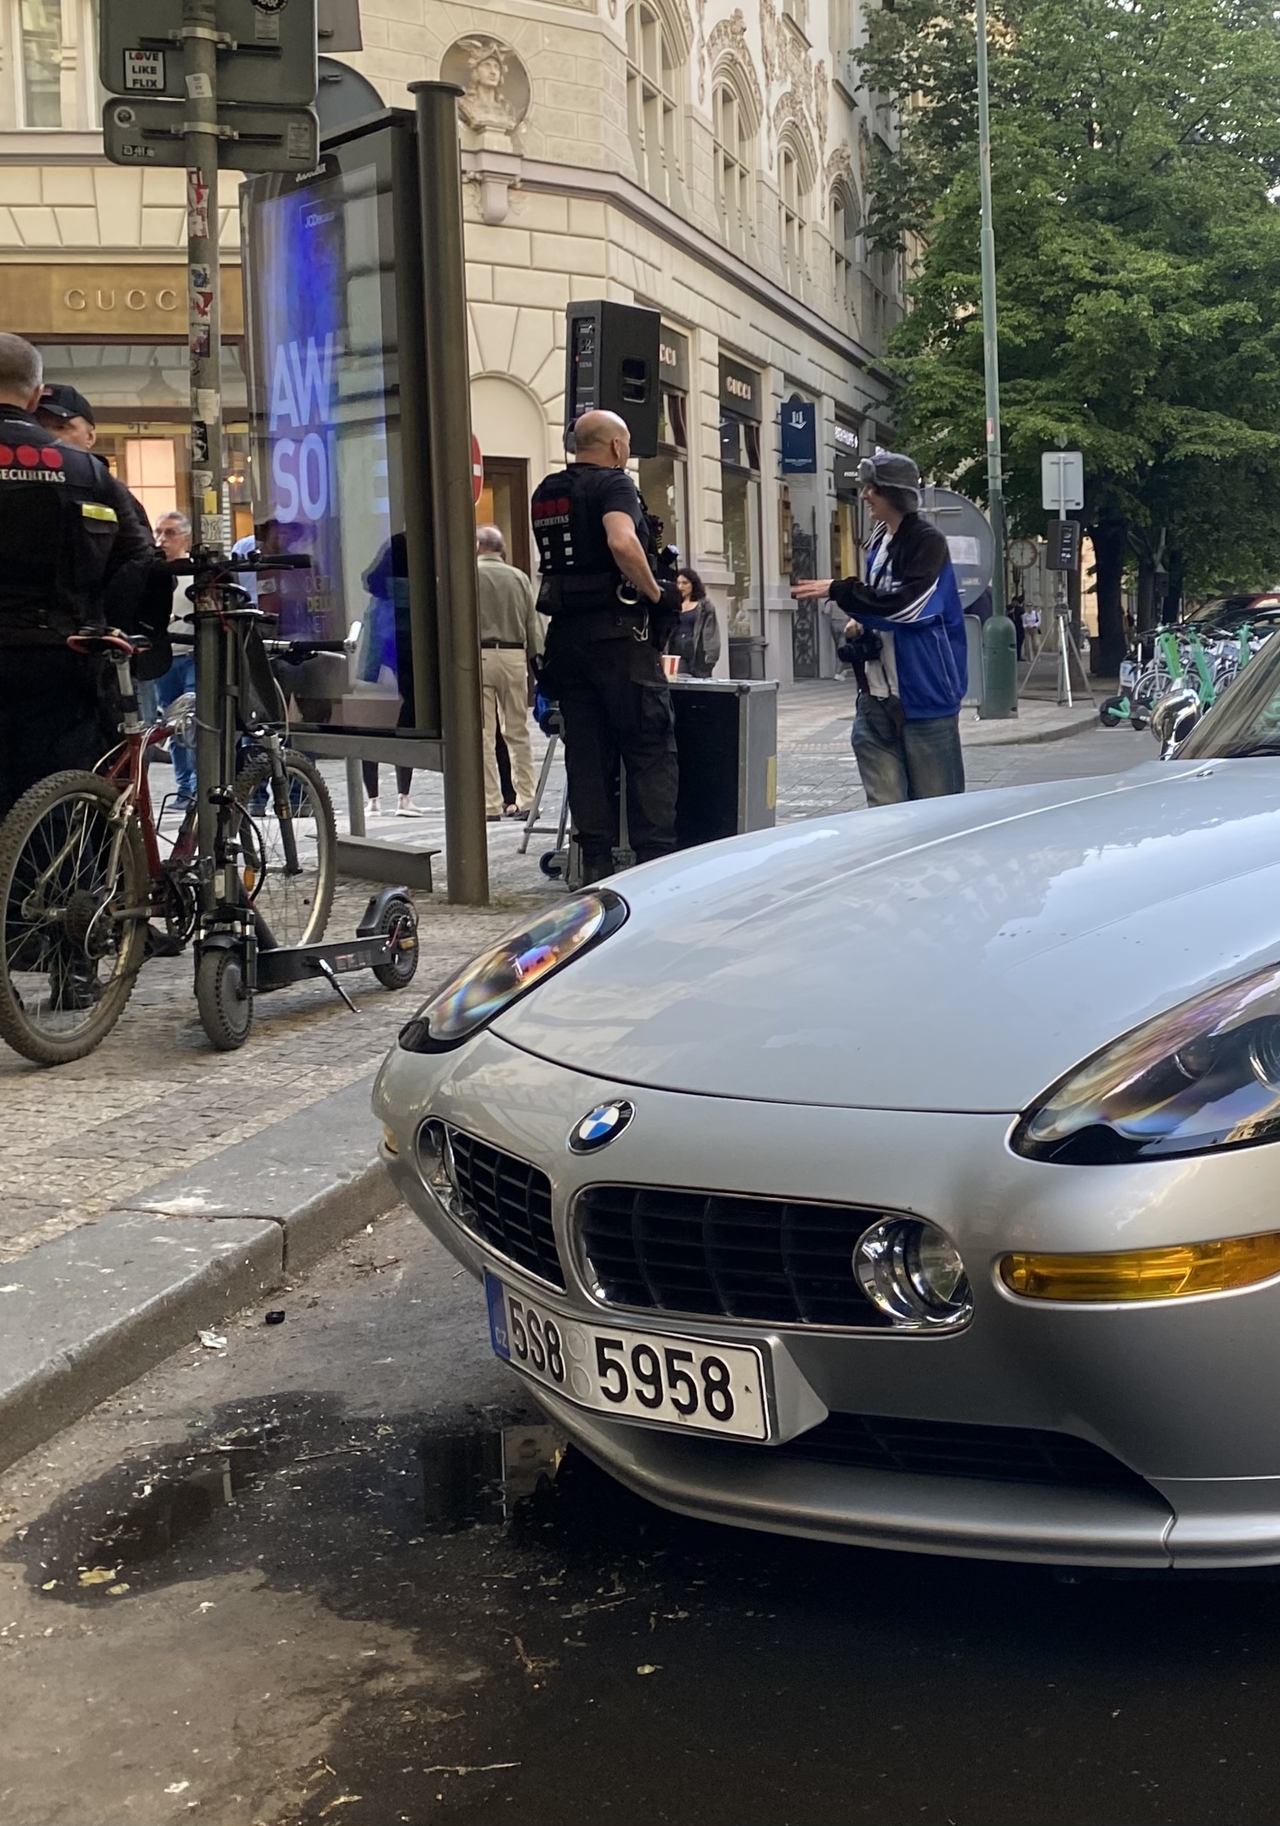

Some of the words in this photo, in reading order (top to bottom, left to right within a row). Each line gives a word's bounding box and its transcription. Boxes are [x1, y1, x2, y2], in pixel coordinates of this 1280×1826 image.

[128, 52, 160, 62] LOVE
[131, 66, 158, 75] LIKE
[132, 79, 158, 88] FLIX
[64, 289, 189, 311] GUCC
[660, 343, 677, 366] CCI
[726, 376, 752, 400] GUCCI
[496, 1326, 511, 1348] CZ
[508, 1295, 566, 1383] 5S8
[595, 1336, 735, 1422] 5958
